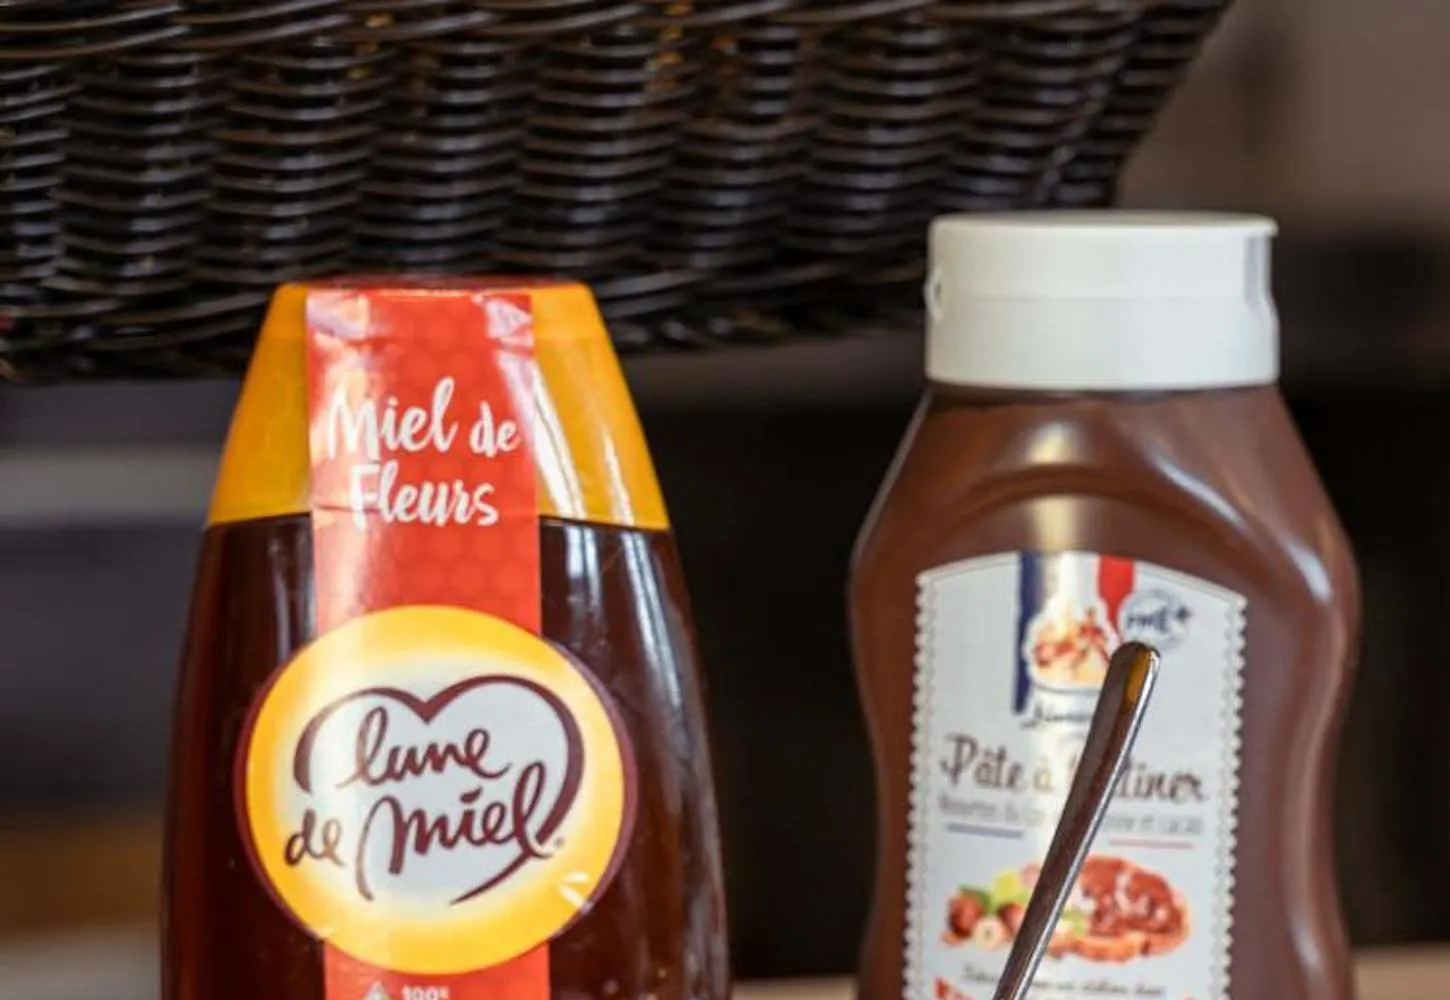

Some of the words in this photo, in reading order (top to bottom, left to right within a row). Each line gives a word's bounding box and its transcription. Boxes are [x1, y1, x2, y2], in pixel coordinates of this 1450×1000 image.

[326, 377, 457, 460] Miel
[470, 401, 521, 458] de
[347, 457, 499, 530] Fleurs
[337, 706, 512, 788] lune
[284, 809, 348, 867] de
[355, 761, 554, 901] miel
